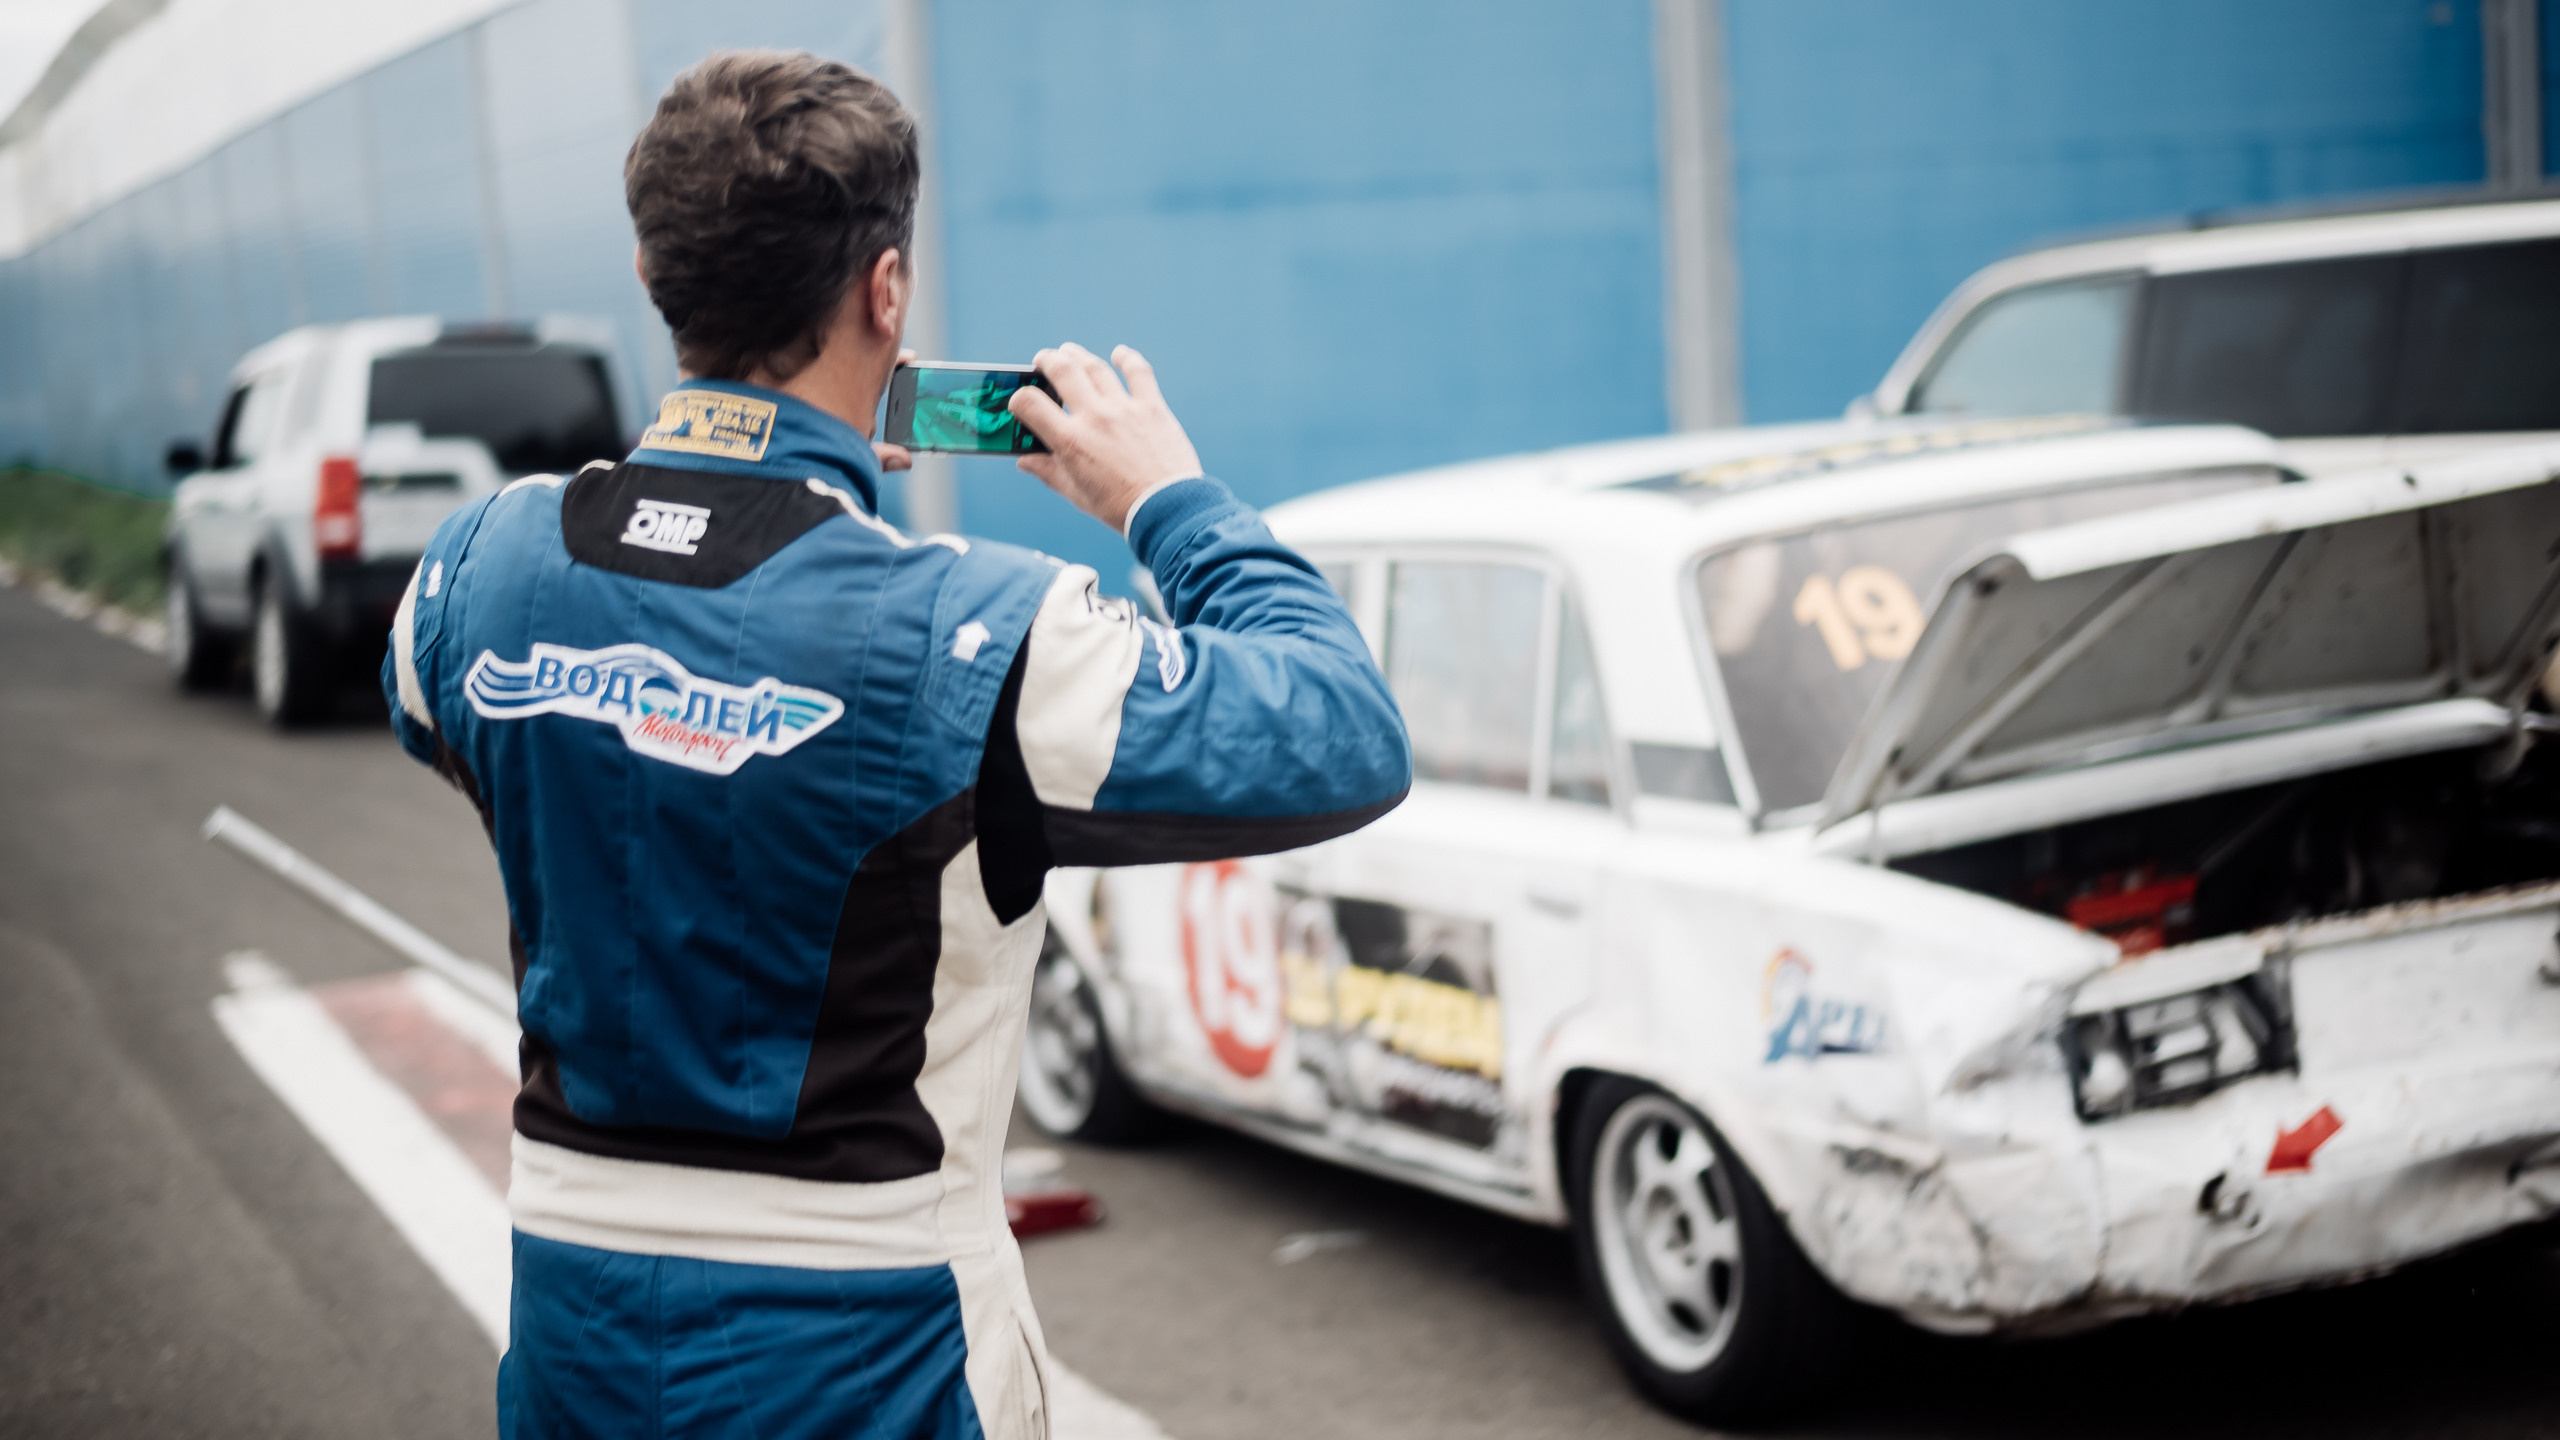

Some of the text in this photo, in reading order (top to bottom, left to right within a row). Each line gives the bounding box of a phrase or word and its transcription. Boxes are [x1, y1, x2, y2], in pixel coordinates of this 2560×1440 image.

[627, 509, 708, 546] OMP
[1793, 564, 1926, 673] 19
[532, 656, 787, 744] ВОДОЛЕЙ
[632, 711, 743, 762] Motorsport
[1187, 863, 1282, 1049] 19
